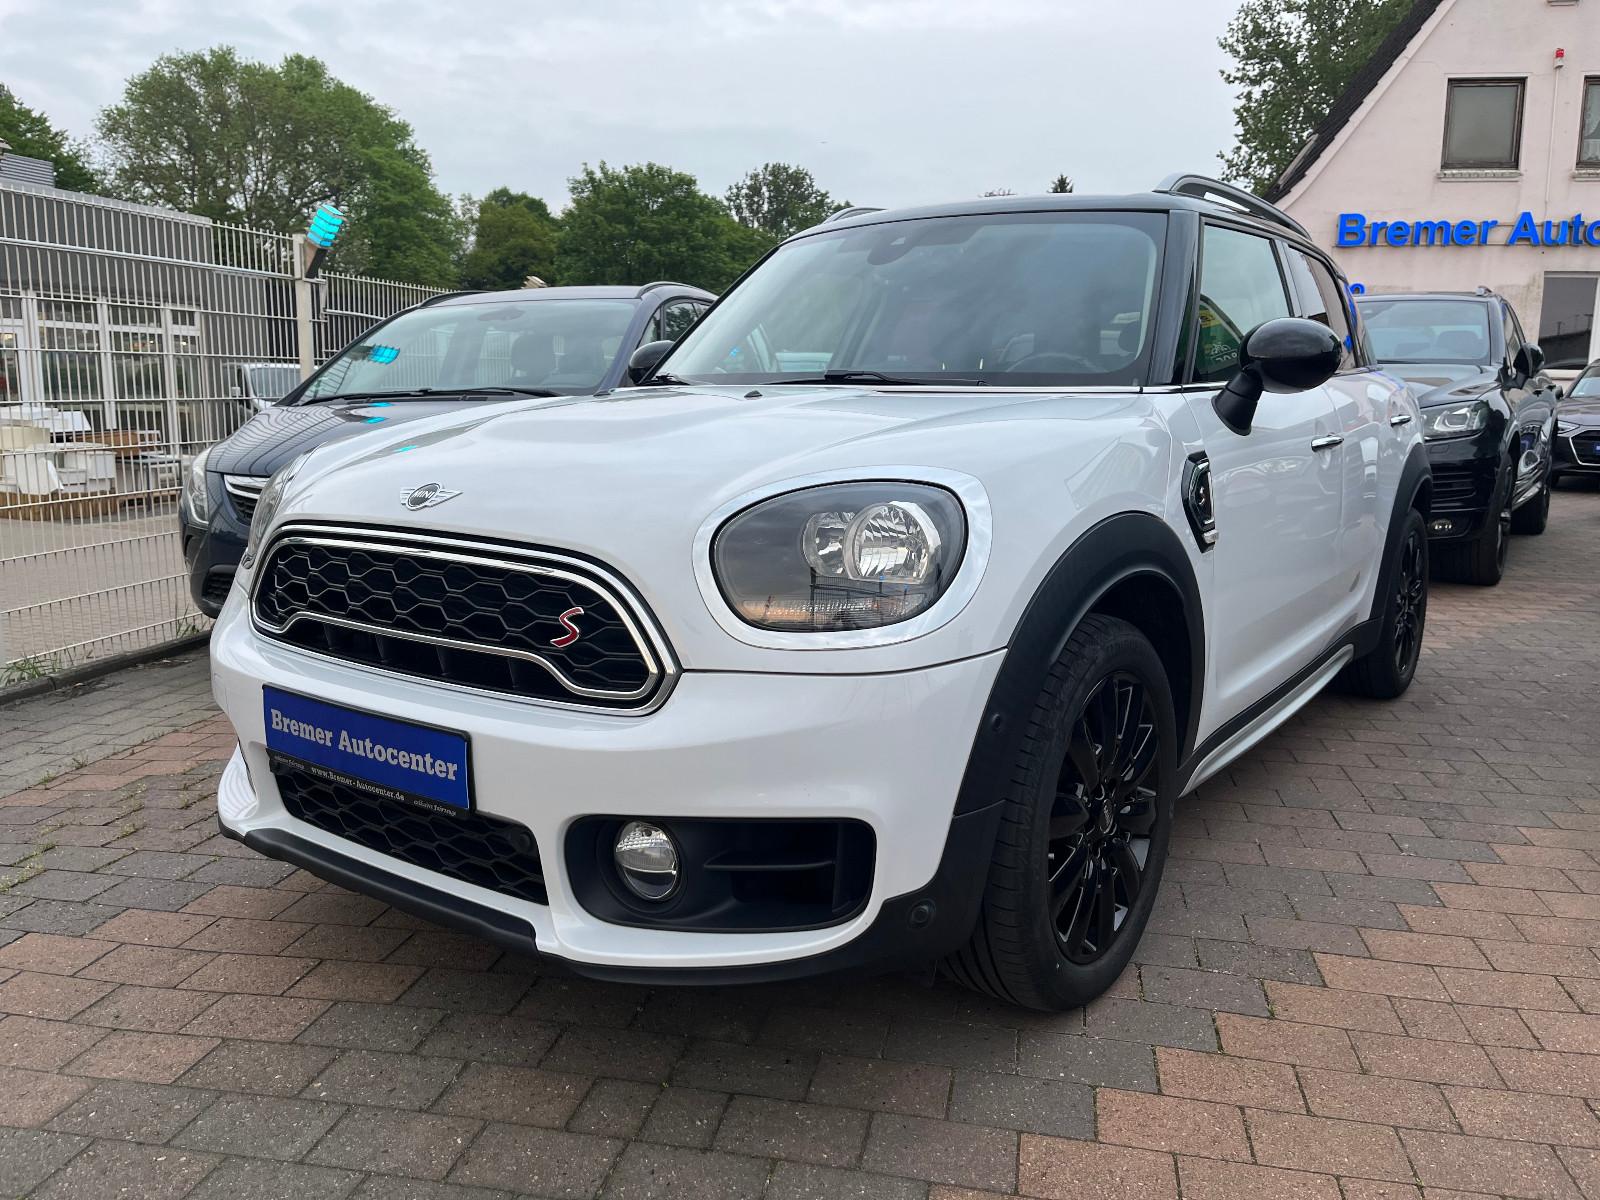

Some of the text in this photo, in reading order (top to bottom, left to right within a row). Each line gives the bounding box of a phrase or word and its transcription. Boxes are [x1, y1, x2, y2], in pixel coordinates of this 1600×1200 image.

[1336, 213, 1498, 248] Bremer
[549, 606, 585, 648] S
[270, 708, 458, 781] Bremer Autocenter
